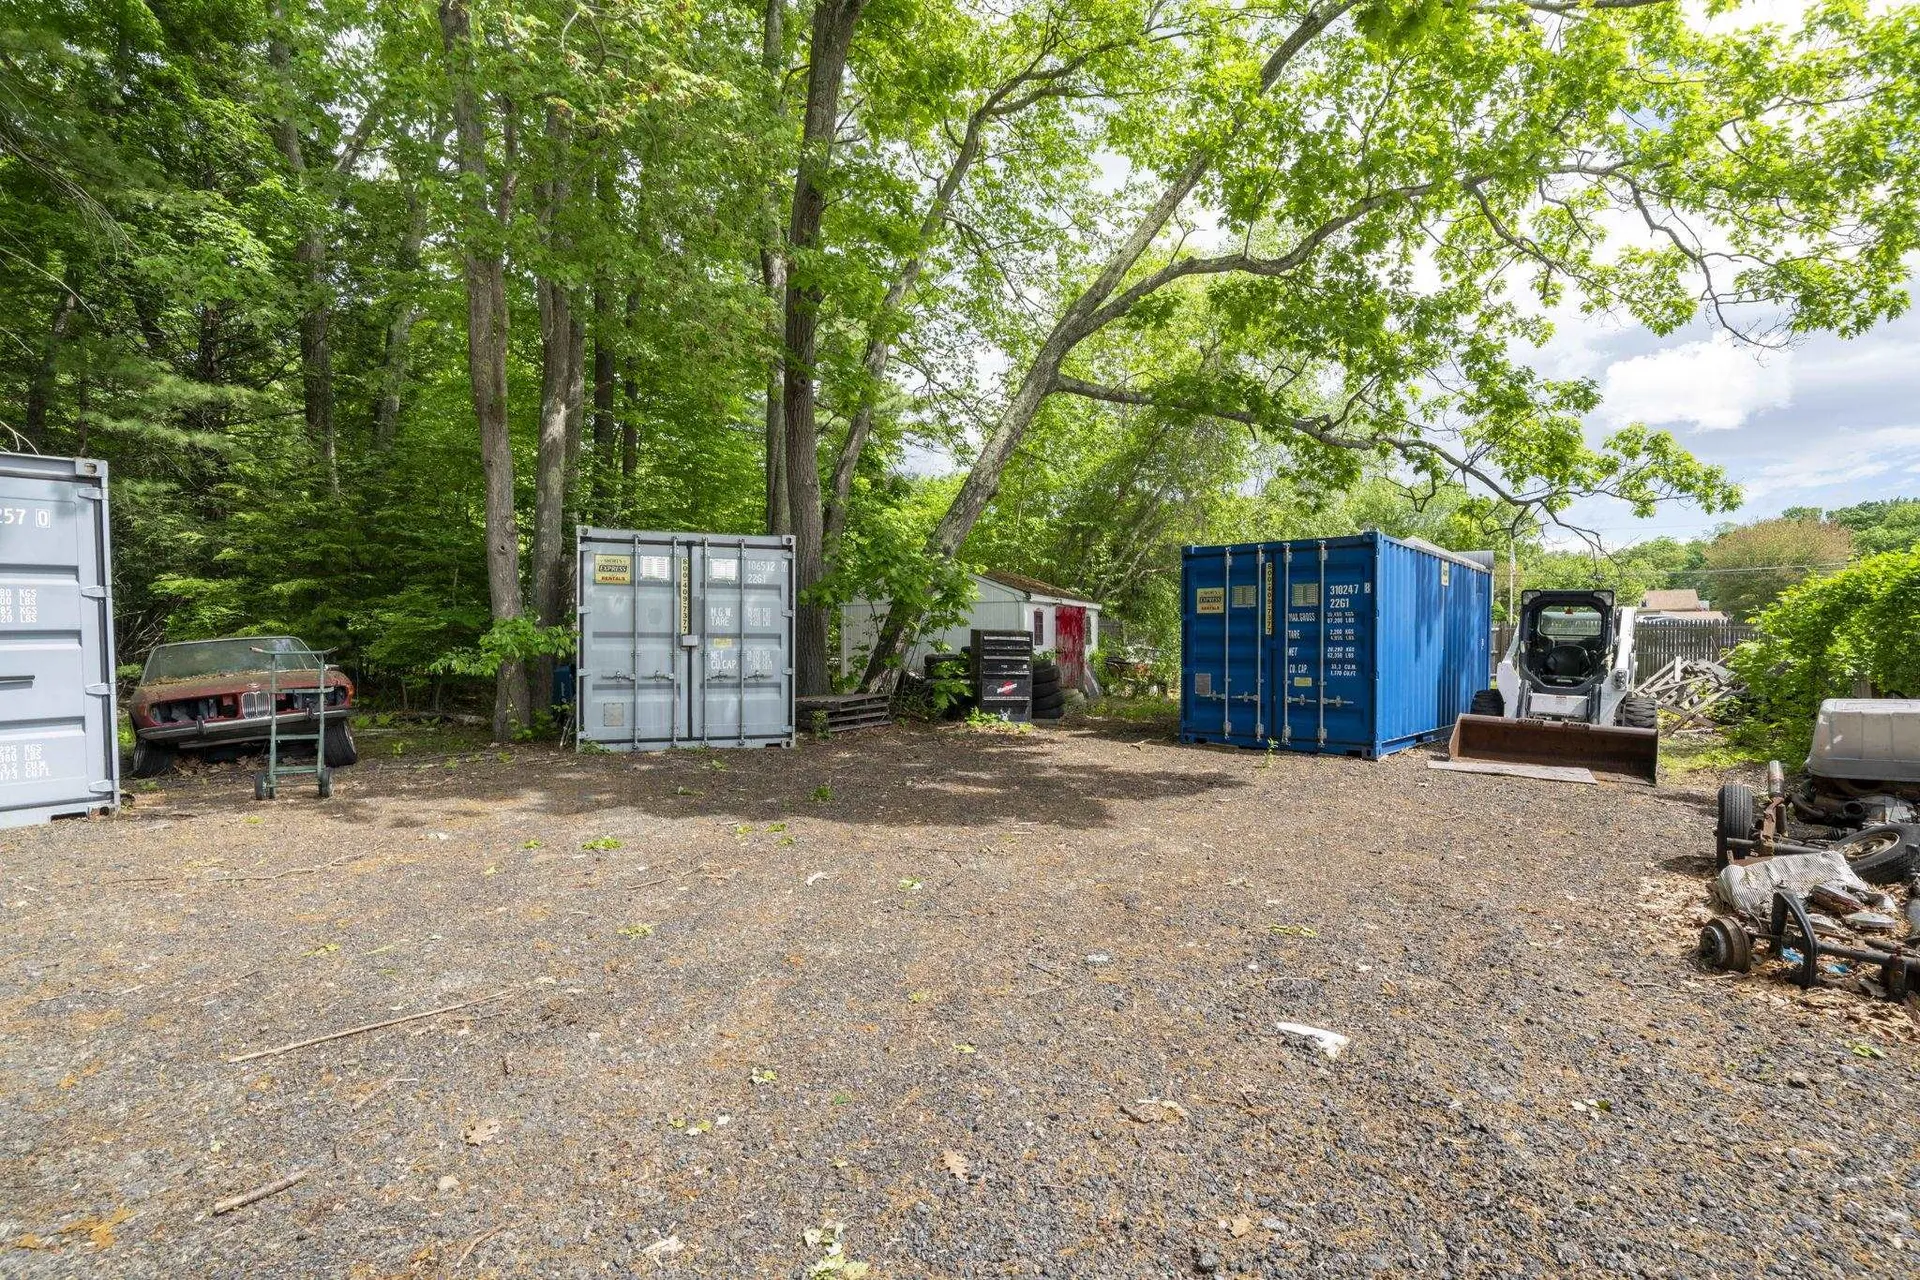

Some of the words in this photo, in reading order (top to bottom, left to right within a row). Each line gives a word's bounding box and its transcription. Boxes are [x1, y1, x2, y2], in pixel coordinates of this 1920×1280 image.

[0, 508, 26, 525] 57
[599, 565, 628, 573] EXPRESS
[19, 588, 37, 598] KGS
[1329, 584, 1359, 595] 310247
[20, 597, 36, 606] LBS
[1329, 598, 1350, 609] 22G1
[20, 614, 37, 623] LBS
